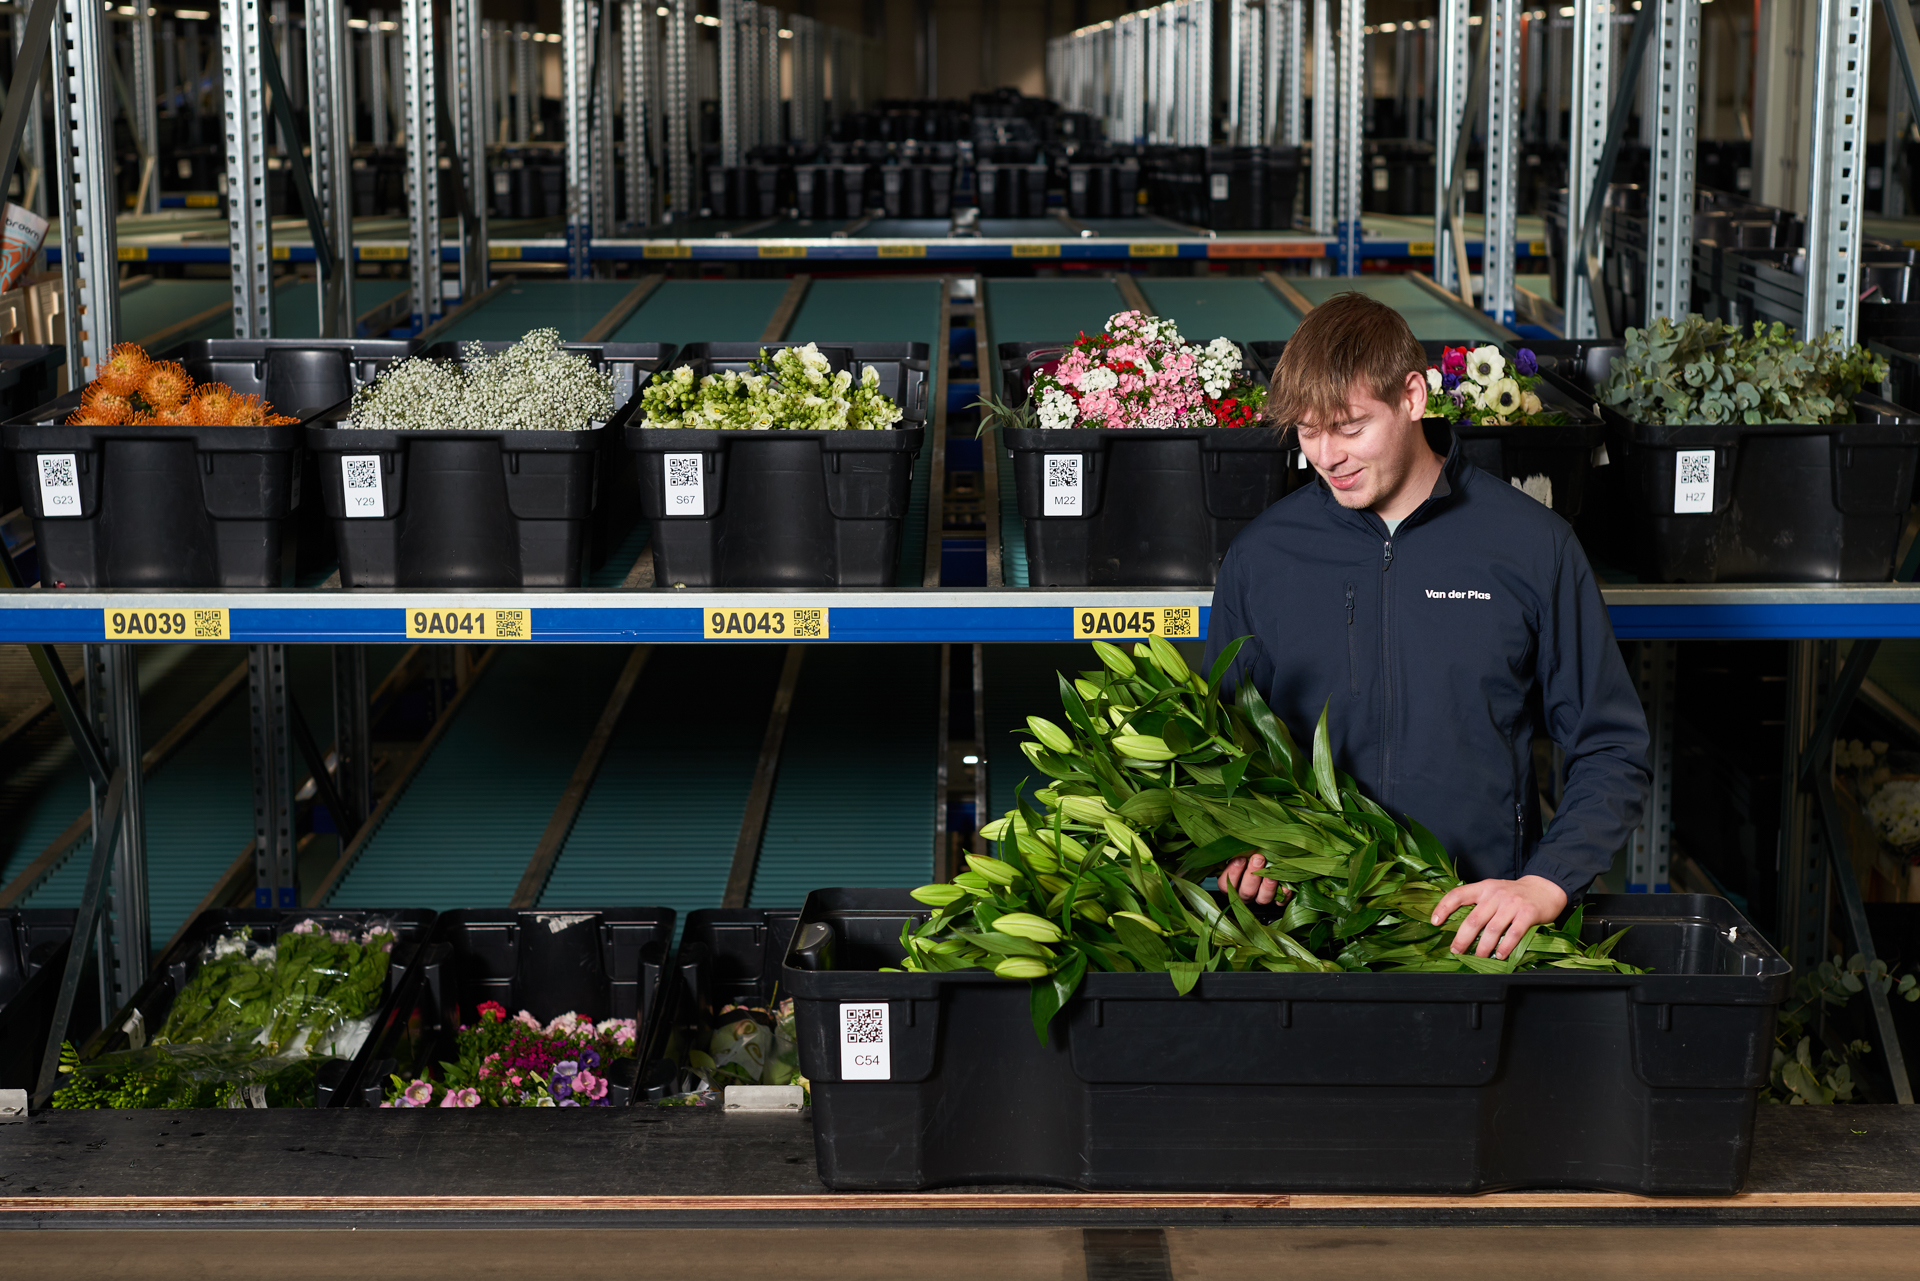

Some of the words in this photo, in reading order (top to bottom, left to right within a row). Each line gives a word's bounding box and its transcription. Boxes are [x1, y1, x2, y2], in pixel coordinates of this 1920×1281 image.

[52, 495, 74, 505] G23
[355, 497, 375, 506] Y29
[676, 495, 696, 505] S67
[1054, 496, 1076, 505] M22
[1685, 492, 1706, 502] H27
[1425, 589, 1446, 599] Van
[1447, 590, 1466, 599] der
[1467, 590, 1491, 600] Plas
[112, 612, 186, 635] 9A039
[413, 611, 485, 635] 9A041
[711, 612, 786, 634] 9A043
[1081, 611, 1156, 634] 9A045
[854, 1055, 880, 1066] C54
